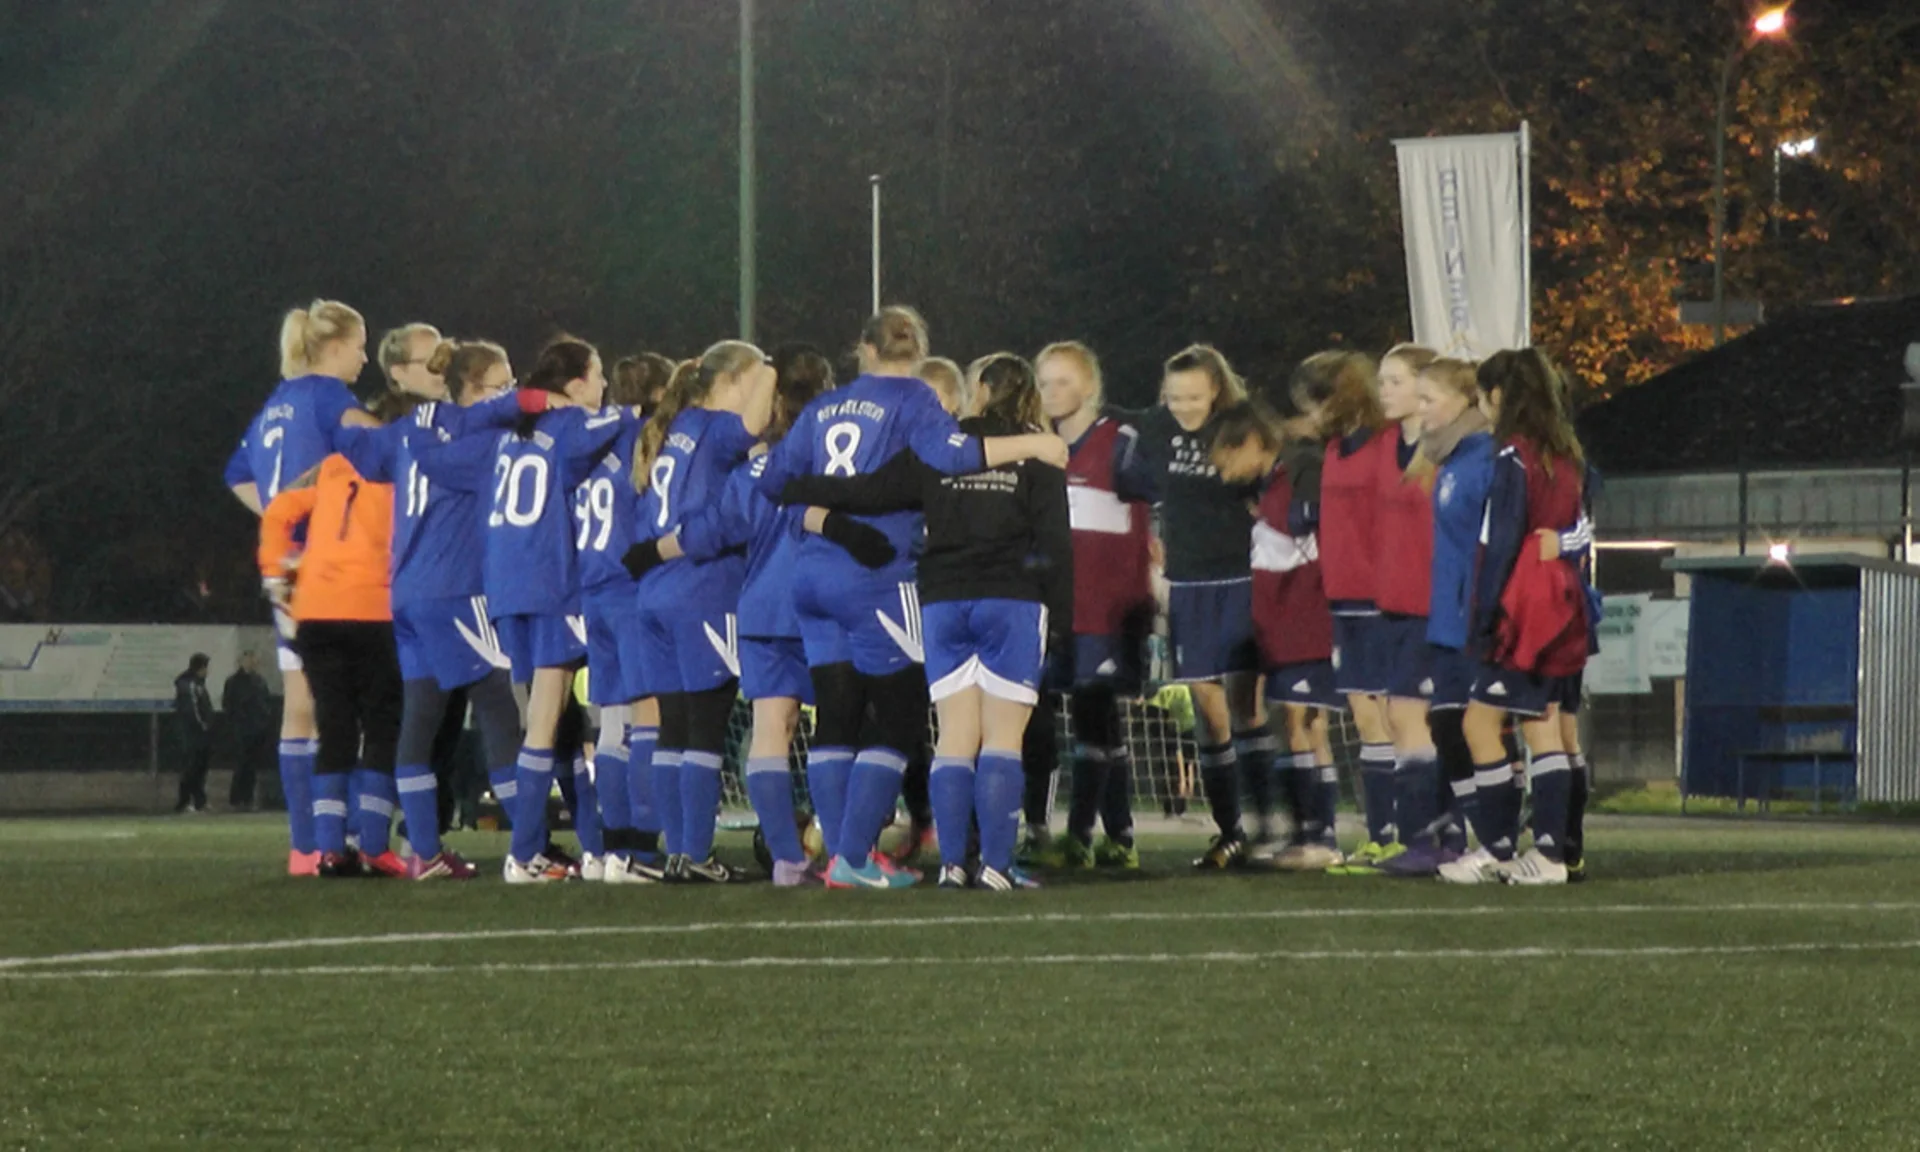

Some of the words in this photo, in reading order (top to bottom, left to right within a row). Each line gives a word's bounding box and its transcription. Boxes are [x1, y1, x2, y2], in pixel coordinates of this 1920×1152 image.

[825, 421, 861, 477] 8
[488, 453, 549, 527] 20
[575, 477, 614, 551] 99
[651, 455, 675, 528] 9
